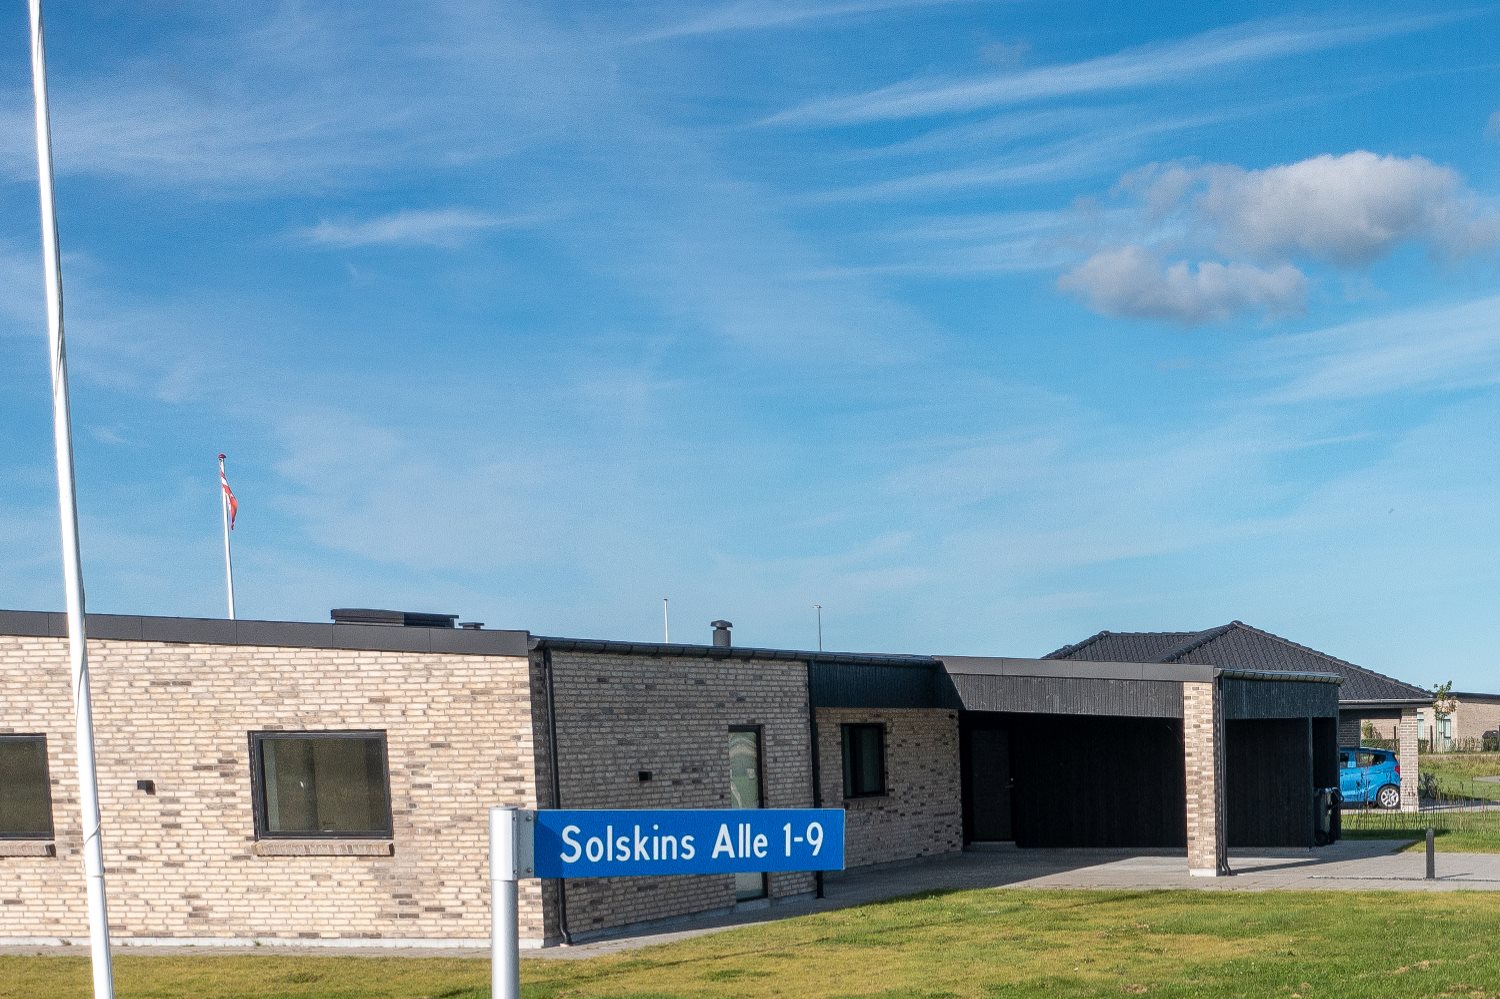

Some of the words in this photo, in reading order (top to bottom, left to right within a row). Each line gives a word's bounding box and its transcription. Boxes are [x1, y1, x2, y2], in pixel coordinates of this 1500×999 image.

[560, 824, 695, 863] Solskins
[711, 823, 768, 859] Alle
[783, 822, 824, 857] 1-9
